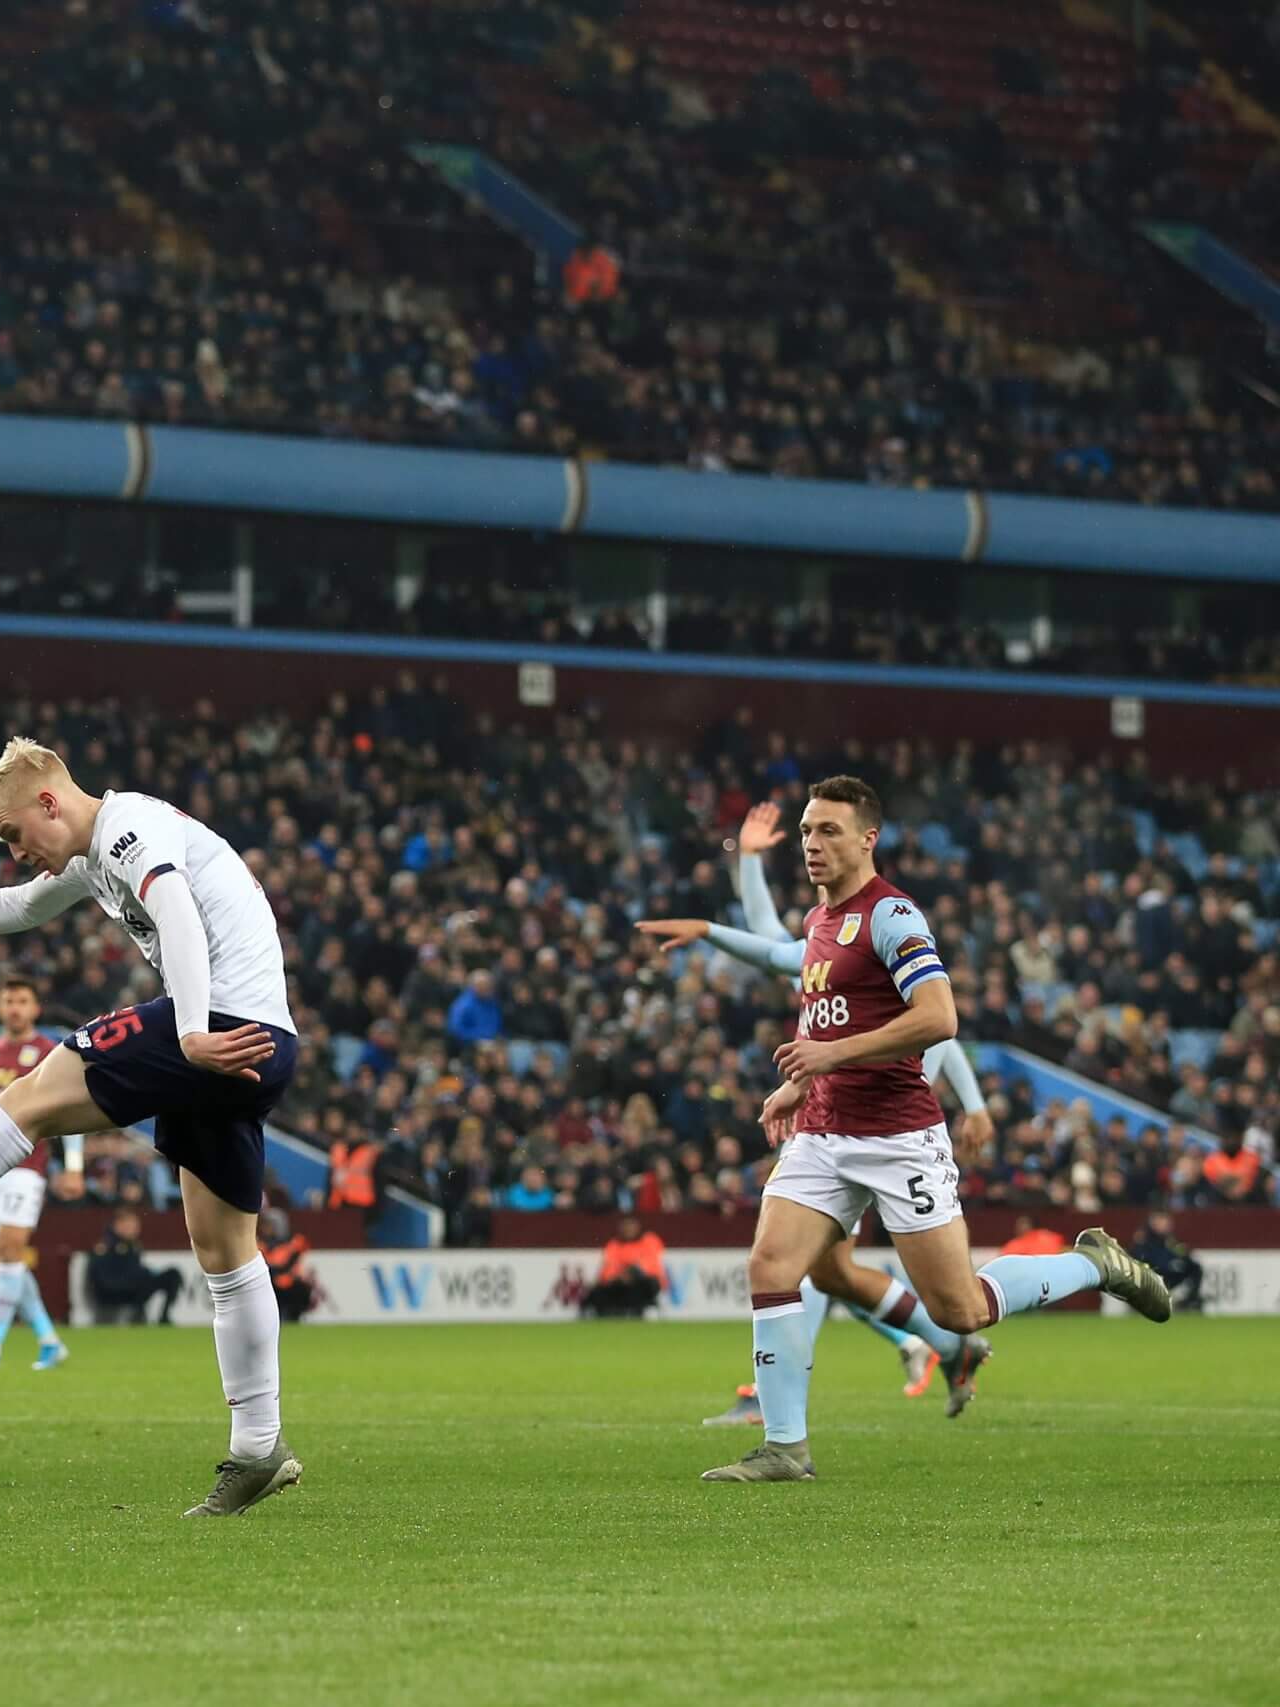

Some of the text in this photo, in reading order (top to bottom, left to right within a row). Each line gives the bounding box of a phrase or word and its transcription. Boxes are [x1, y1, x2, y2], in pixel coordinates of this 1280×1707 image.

[110, 831, 138, 859] WU
[907, 1175, 935, 1215] 5
[438, 1264, 516, 1310] W88
[699, 1265, 748, 1308] W8
